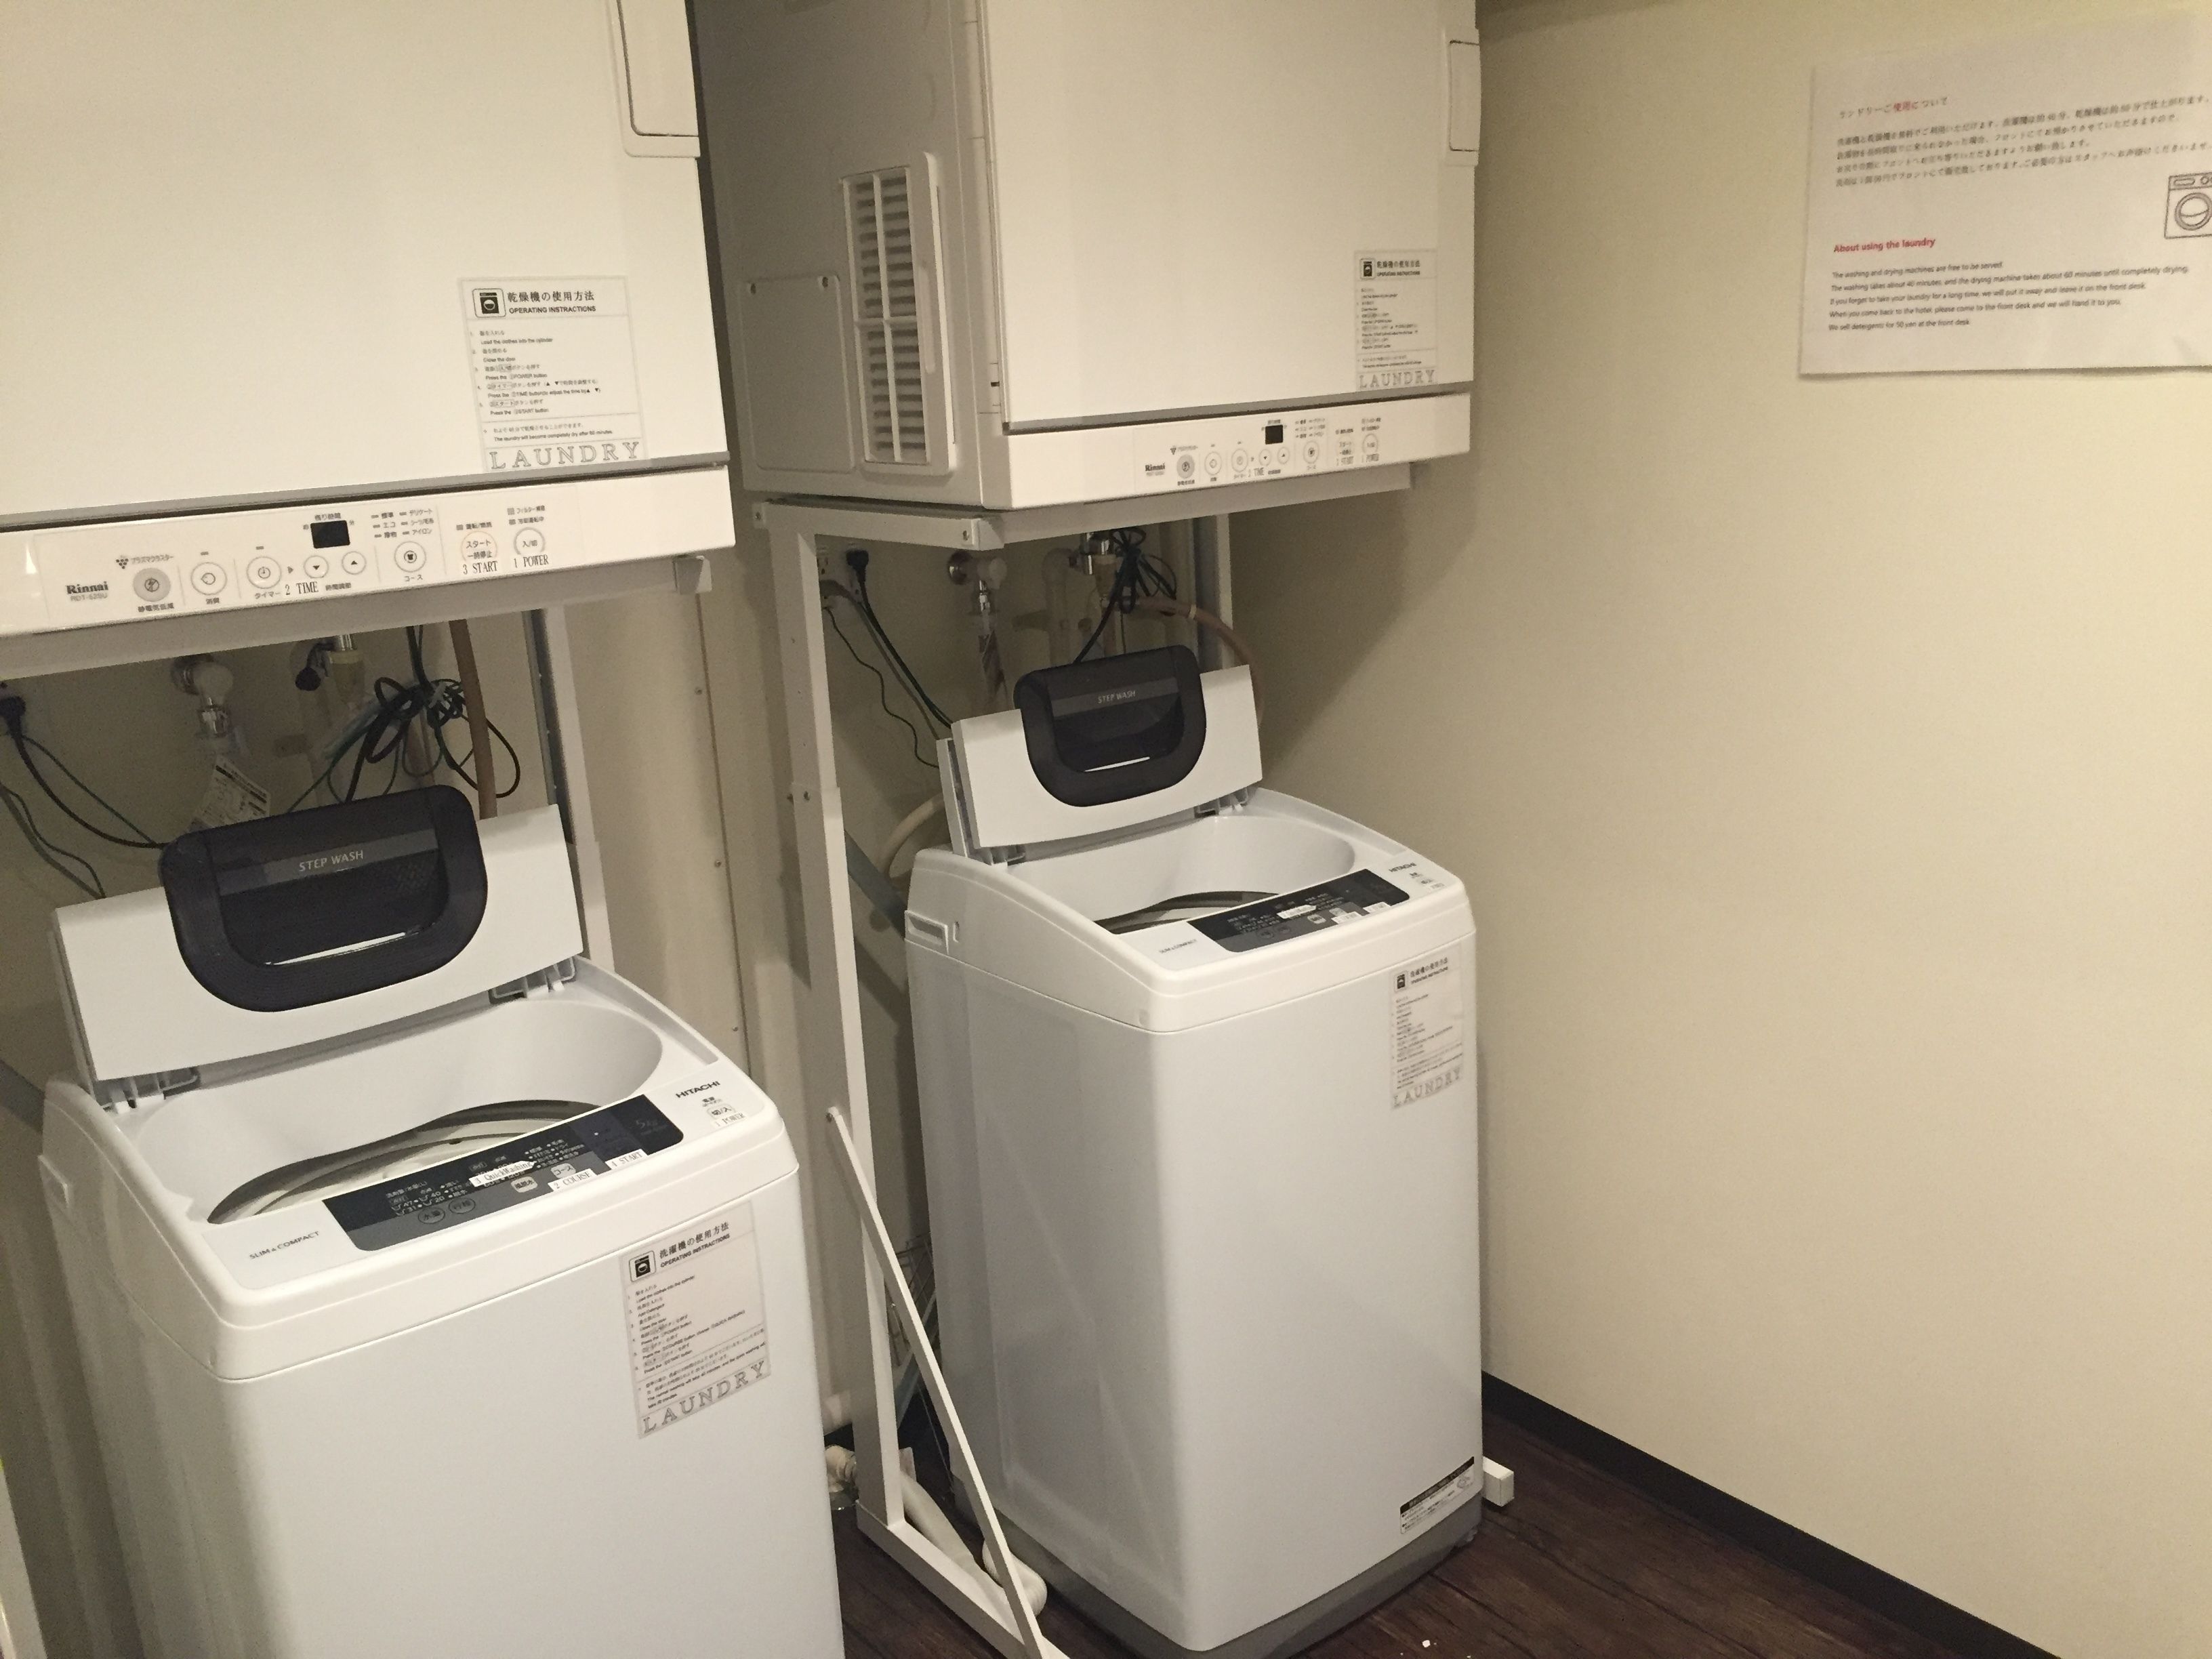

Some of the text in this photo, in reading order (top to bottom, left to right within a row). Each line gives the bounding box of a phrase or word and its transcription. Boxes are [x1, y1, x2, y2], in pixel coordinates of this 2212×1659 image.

[1834, 237, 1935, 251] About using the laundry
[1971, 276, 1991, 285] drying
[508, 291, 594, 302] 乾燥機の使用方法
[509, 305, 596, 314] OPERATING INSTRACTIONS
[1359, 369, 1435, 388] LAUNDRY
[489, 442, 639, 470] LAUNDRY
[1145, 462, 1166, 472] Rinnai
[466, 539, 491, 549] スタート
[467, 550, 492, 560] 一時停止
[514, 554, 549, 569] 1 POWER
[462, 560, 499, 575] 3 START
[404, 575, 423, 583] コース
[66, 581, 109, 595] Rinnai
[254, 590, 281, 599] タイマー
[285, 581, 319, 596] 2 TIME
[1098, 690, 1136, 703] STEP WASH
[299, 850, 363, 872] STEP WASH
[676, 1081, 720, 1098] HITACHI
[1393, 1066, 1461, 1109] LAUNDRY
[619, 1151, 642, 1165] START
[484, 1162, 532, 1181] QuickWashing
[554, 1166, 574, 1176] コース
[561, 1170, 592, 1186] COURSE
[659, 1221, 729, 1259] 洗濯機の使用方法
[660, 1233, 730, 1268] OPERATING INSTRACTIONS
[642, 1360, 764, 1434] LAUNDRY
